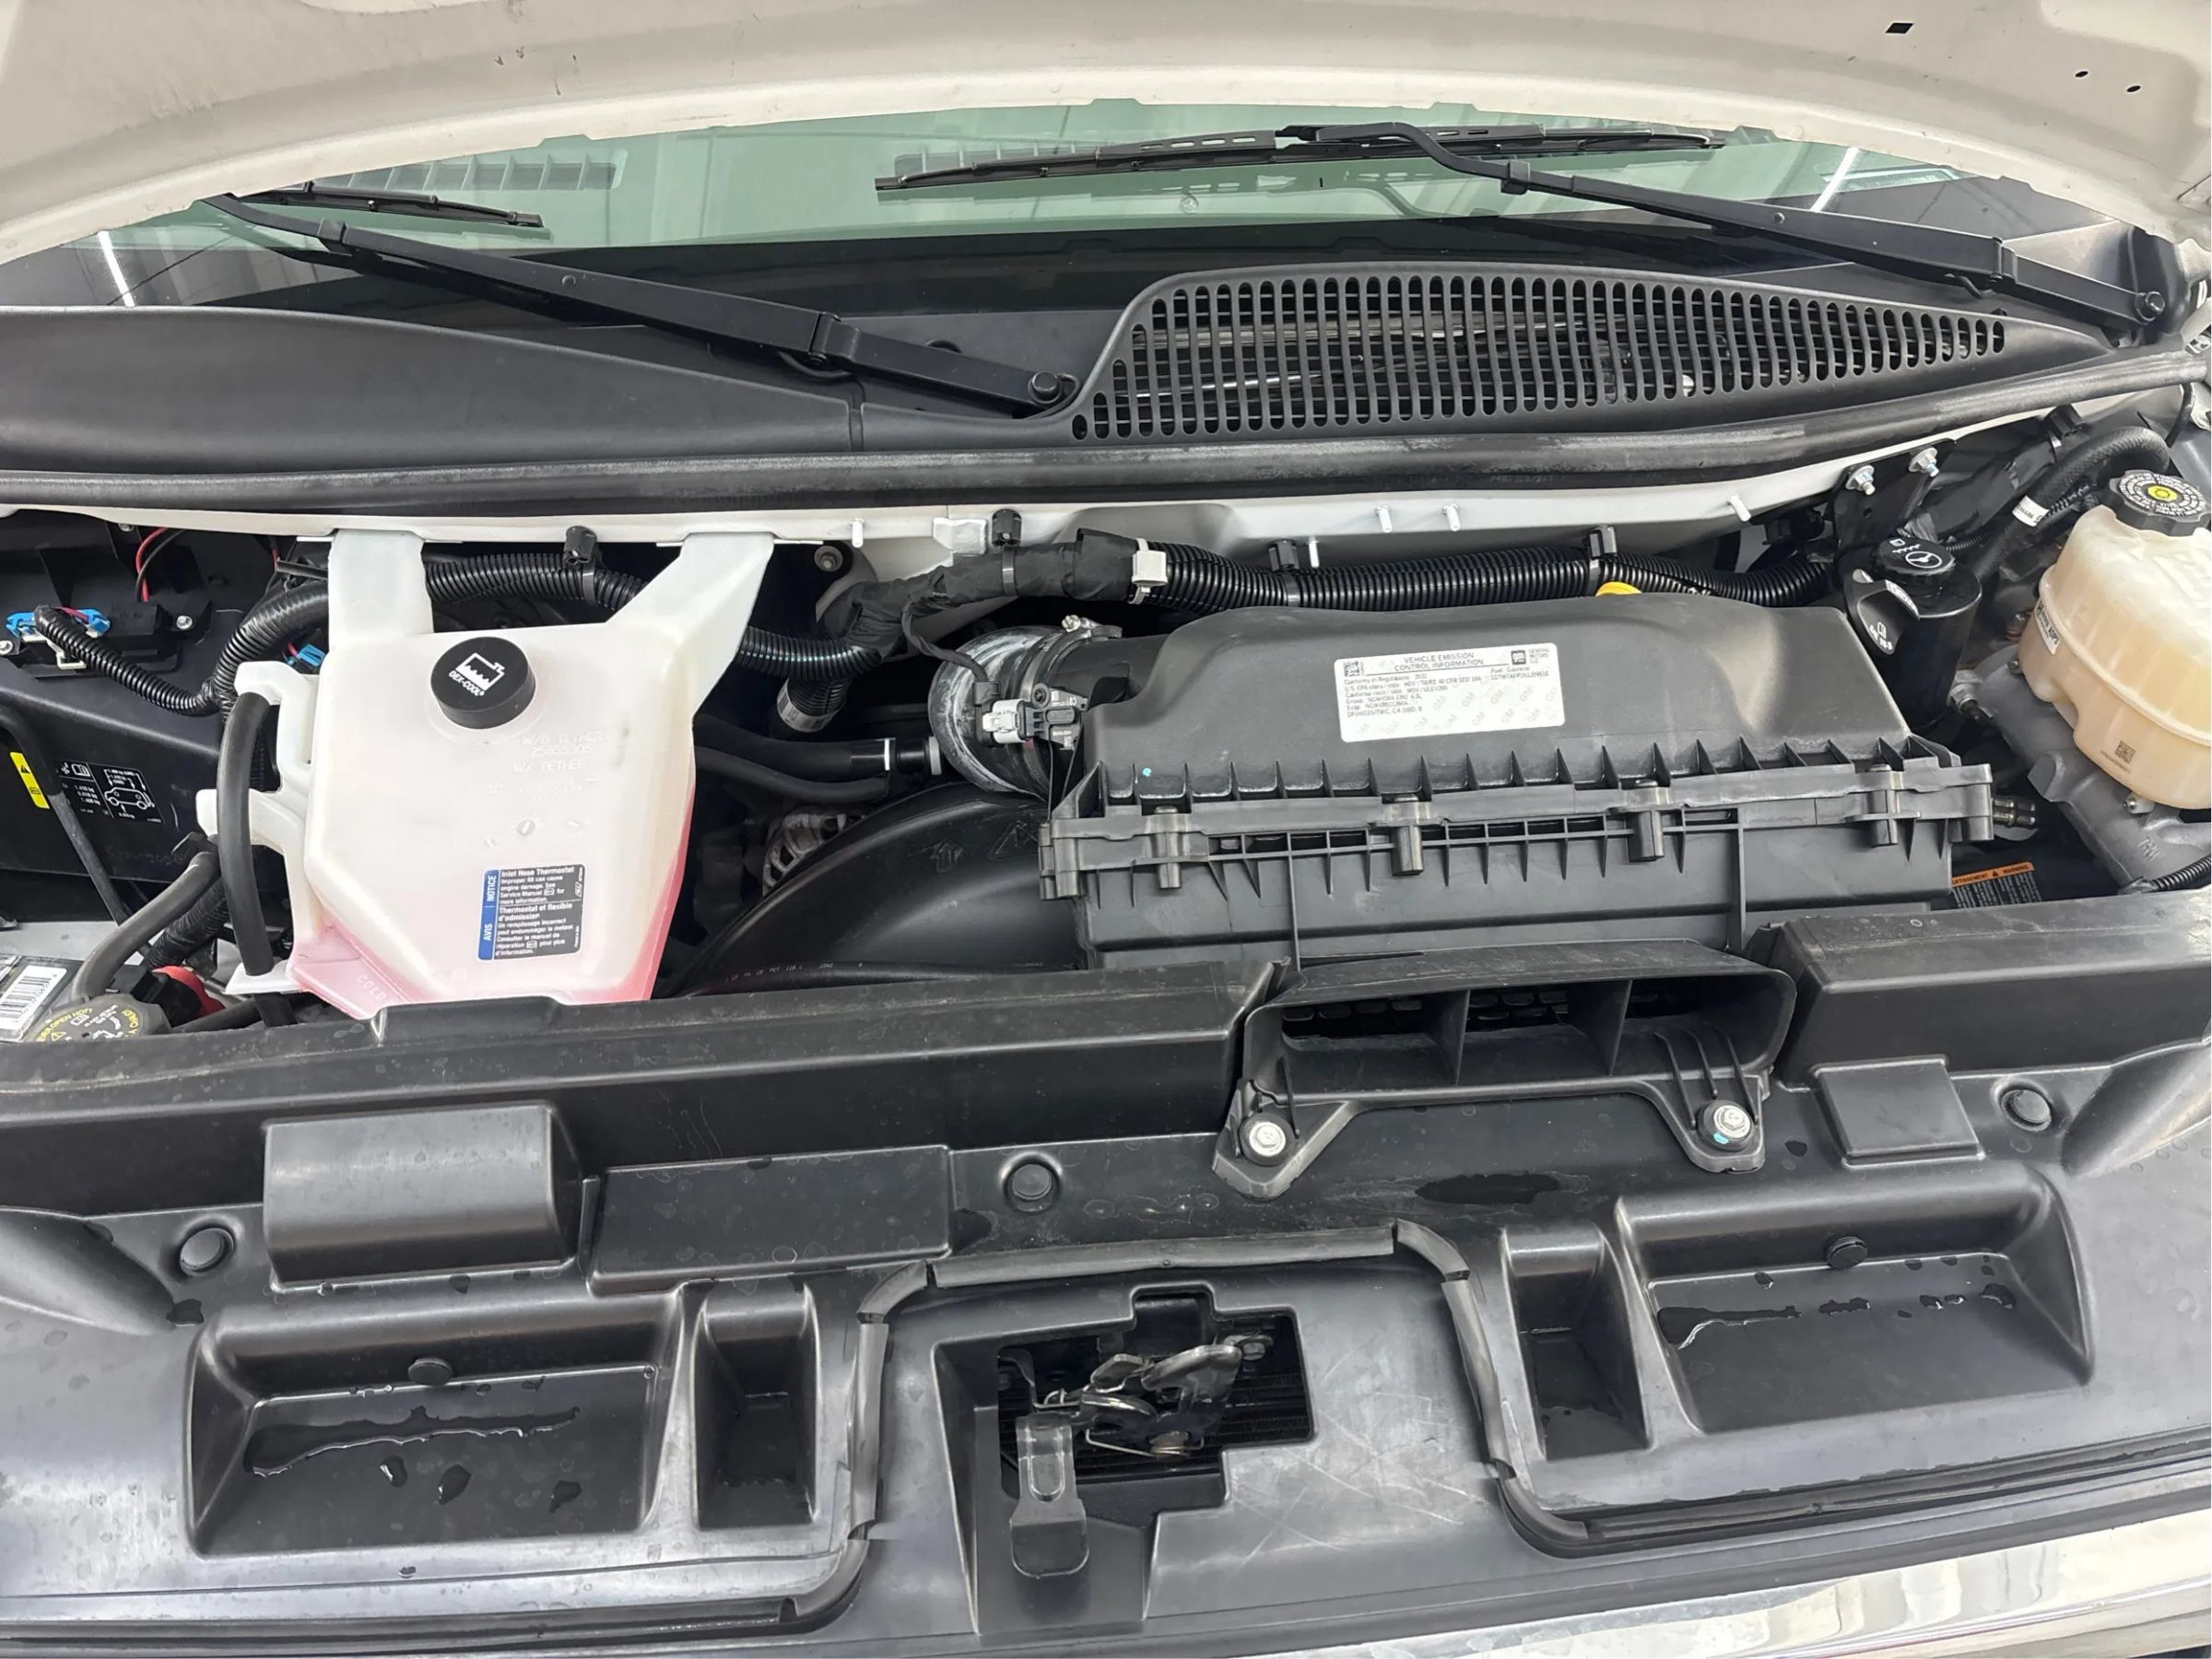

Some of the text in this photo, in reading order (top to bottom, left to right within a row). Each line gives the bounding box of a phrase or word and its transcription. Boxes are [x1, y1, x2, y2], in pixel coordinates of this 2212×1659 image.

[1404, 652, 1475, 664] VEHICLE EMISSION
[1394, 658, 1484, 672] CONTROL INFORMATION
[535, 866, 575, 876] Thermostat
[487, 875, 497, 902] NOTICE
[500, 904, 538, 913] Thermostat
[547, 902, 573, 911] flexible
[499, 912, 540, 922] d'admission
[483, 924, 493, 941] AVIS
[356, 974, 388, 1002] COLD
